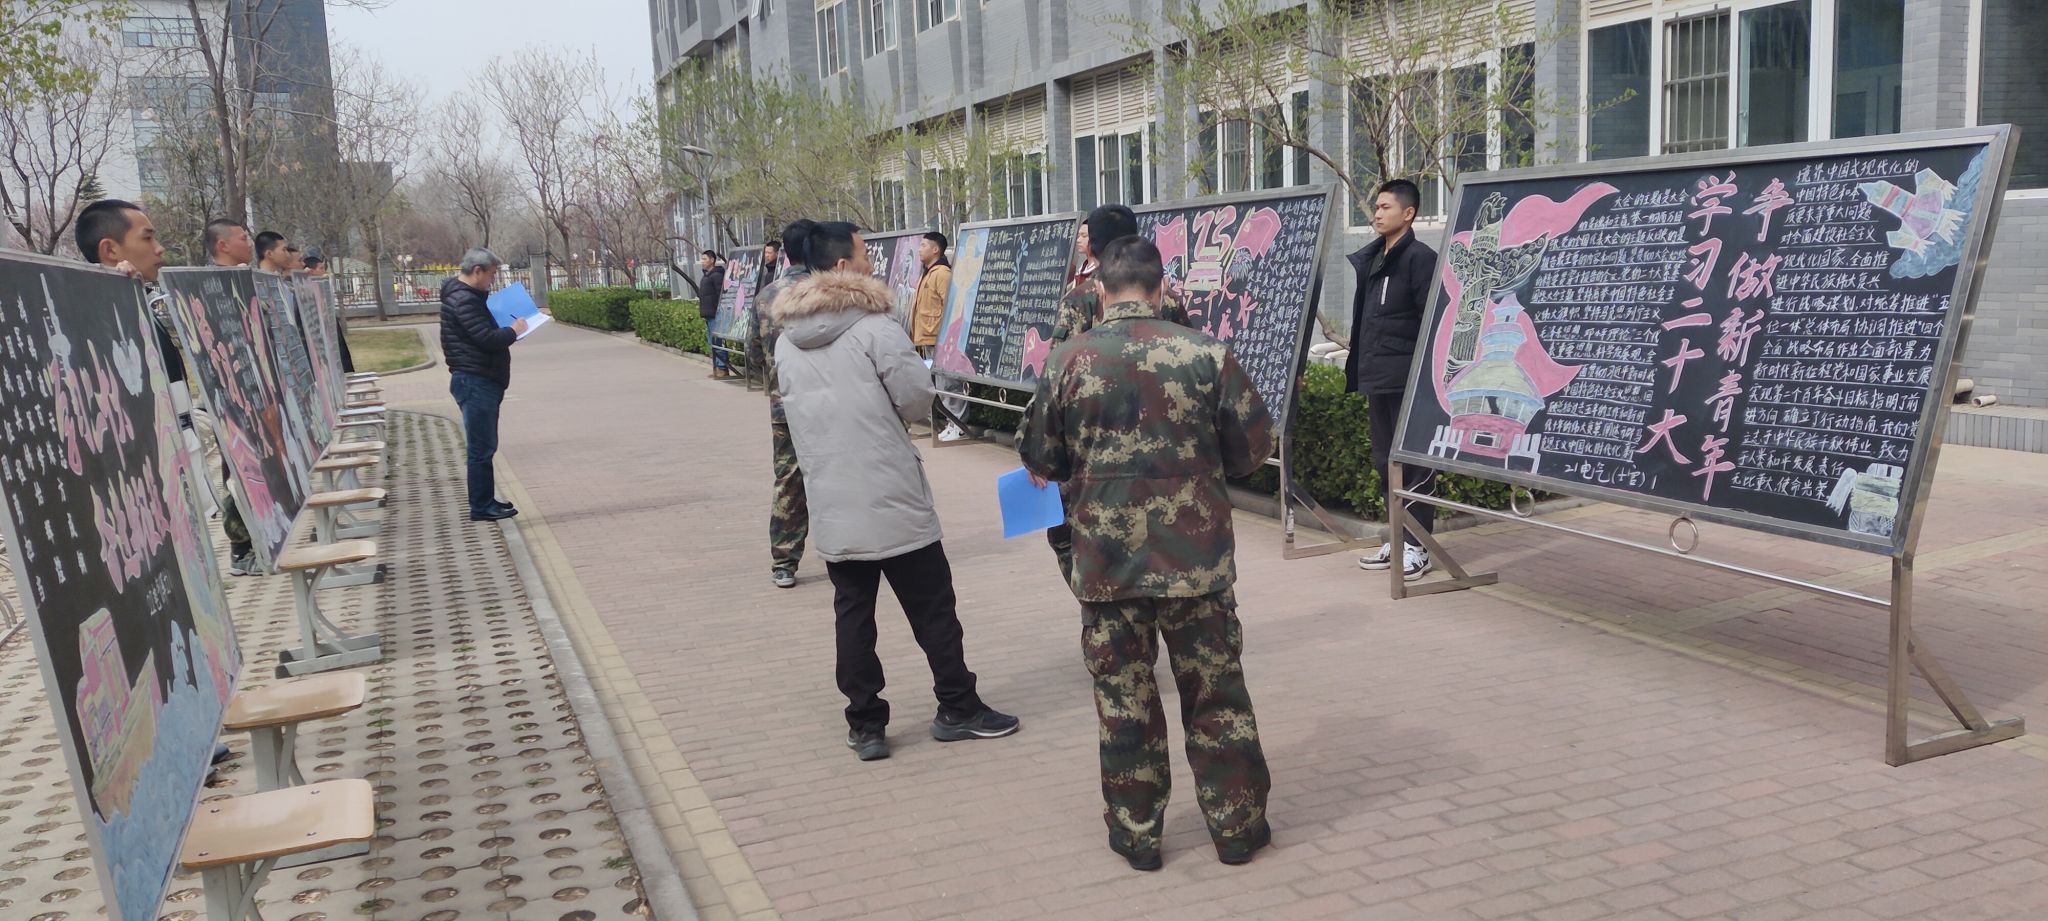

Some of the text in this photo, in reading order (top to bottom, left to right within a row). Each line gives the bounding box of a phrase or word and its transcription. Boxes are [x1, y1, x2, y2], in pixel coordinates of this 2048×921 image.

[1776, 272, 1881, 290] 进中华民族伟大复兴
[1780, 225, 1877, 246] 对全面建设社会主义
[1637, 170, 1739, 465] 学习二十大
[1691, 178, 1795, 502] 争做新青年
